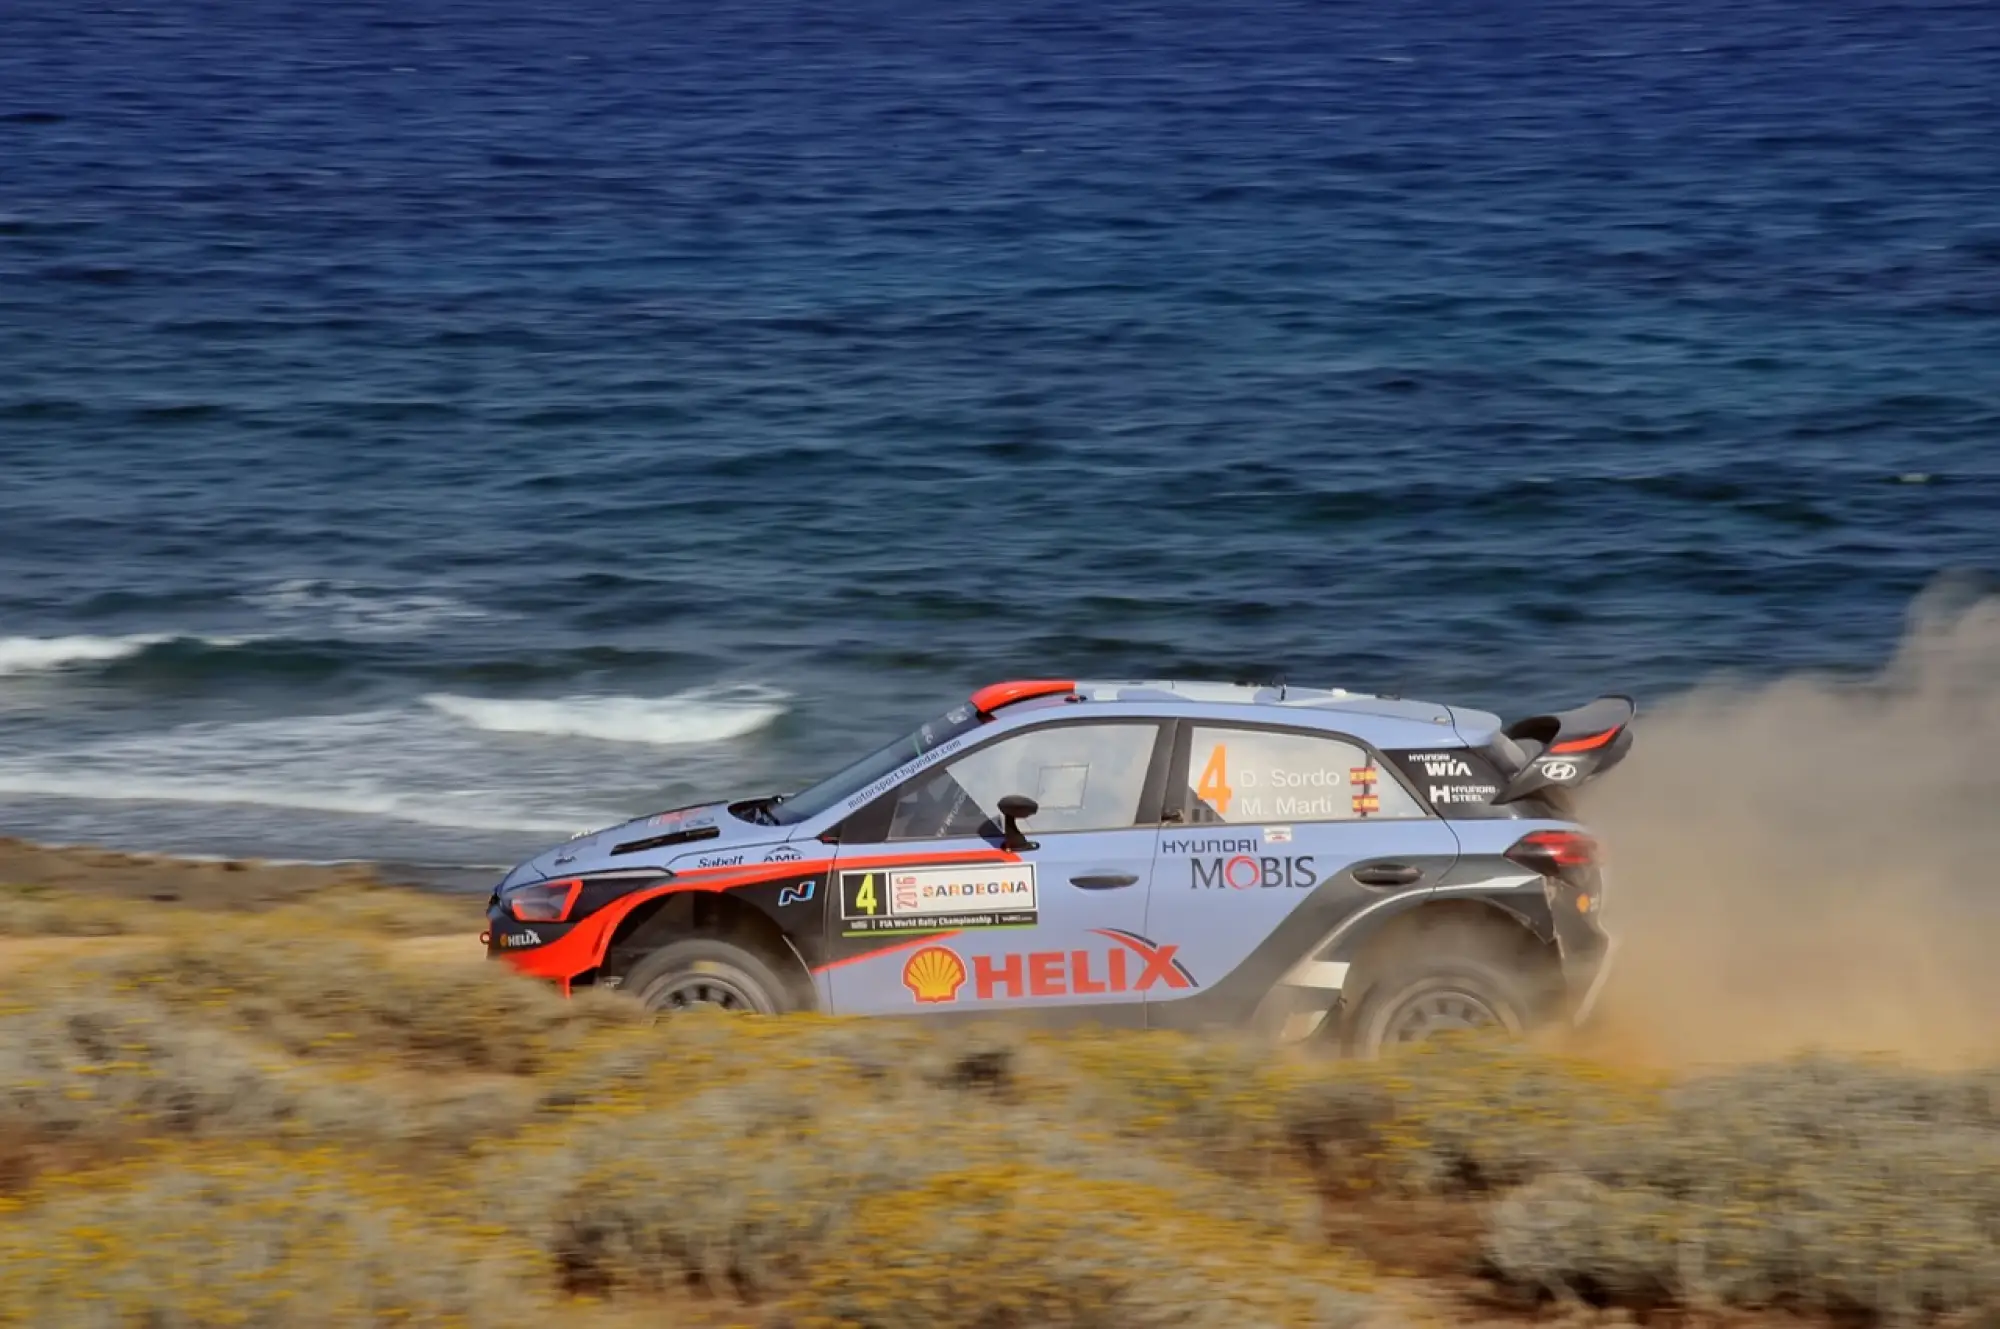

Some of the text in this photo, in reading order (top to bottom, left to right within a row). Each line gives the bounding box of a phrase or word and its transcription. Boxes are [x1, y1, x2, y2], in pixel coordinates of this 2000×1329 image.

[1197, 743, 1231, 814] 4
[1240, 769, 1263, 788] D.
[1271, 767, 1340, 788] Sordo
[1241, 797, 1268, 815] M.
[1162, 839, 1258, 854] HYUNDAI
[1190, 855, 1317, 889] MOBIS
[855, 873, 878, 915] 4
[897, 876, 918, 910] 2016
[922, 880, 1029, 898] SARDEGNA
[894, 918, 917, 927] World
[918, 918, 938, 928] Rally
[938, 915, 992, 926] Championship
[508, 929, 541, 947] HELIX
[972, 930, 1197, 999] HELIX
